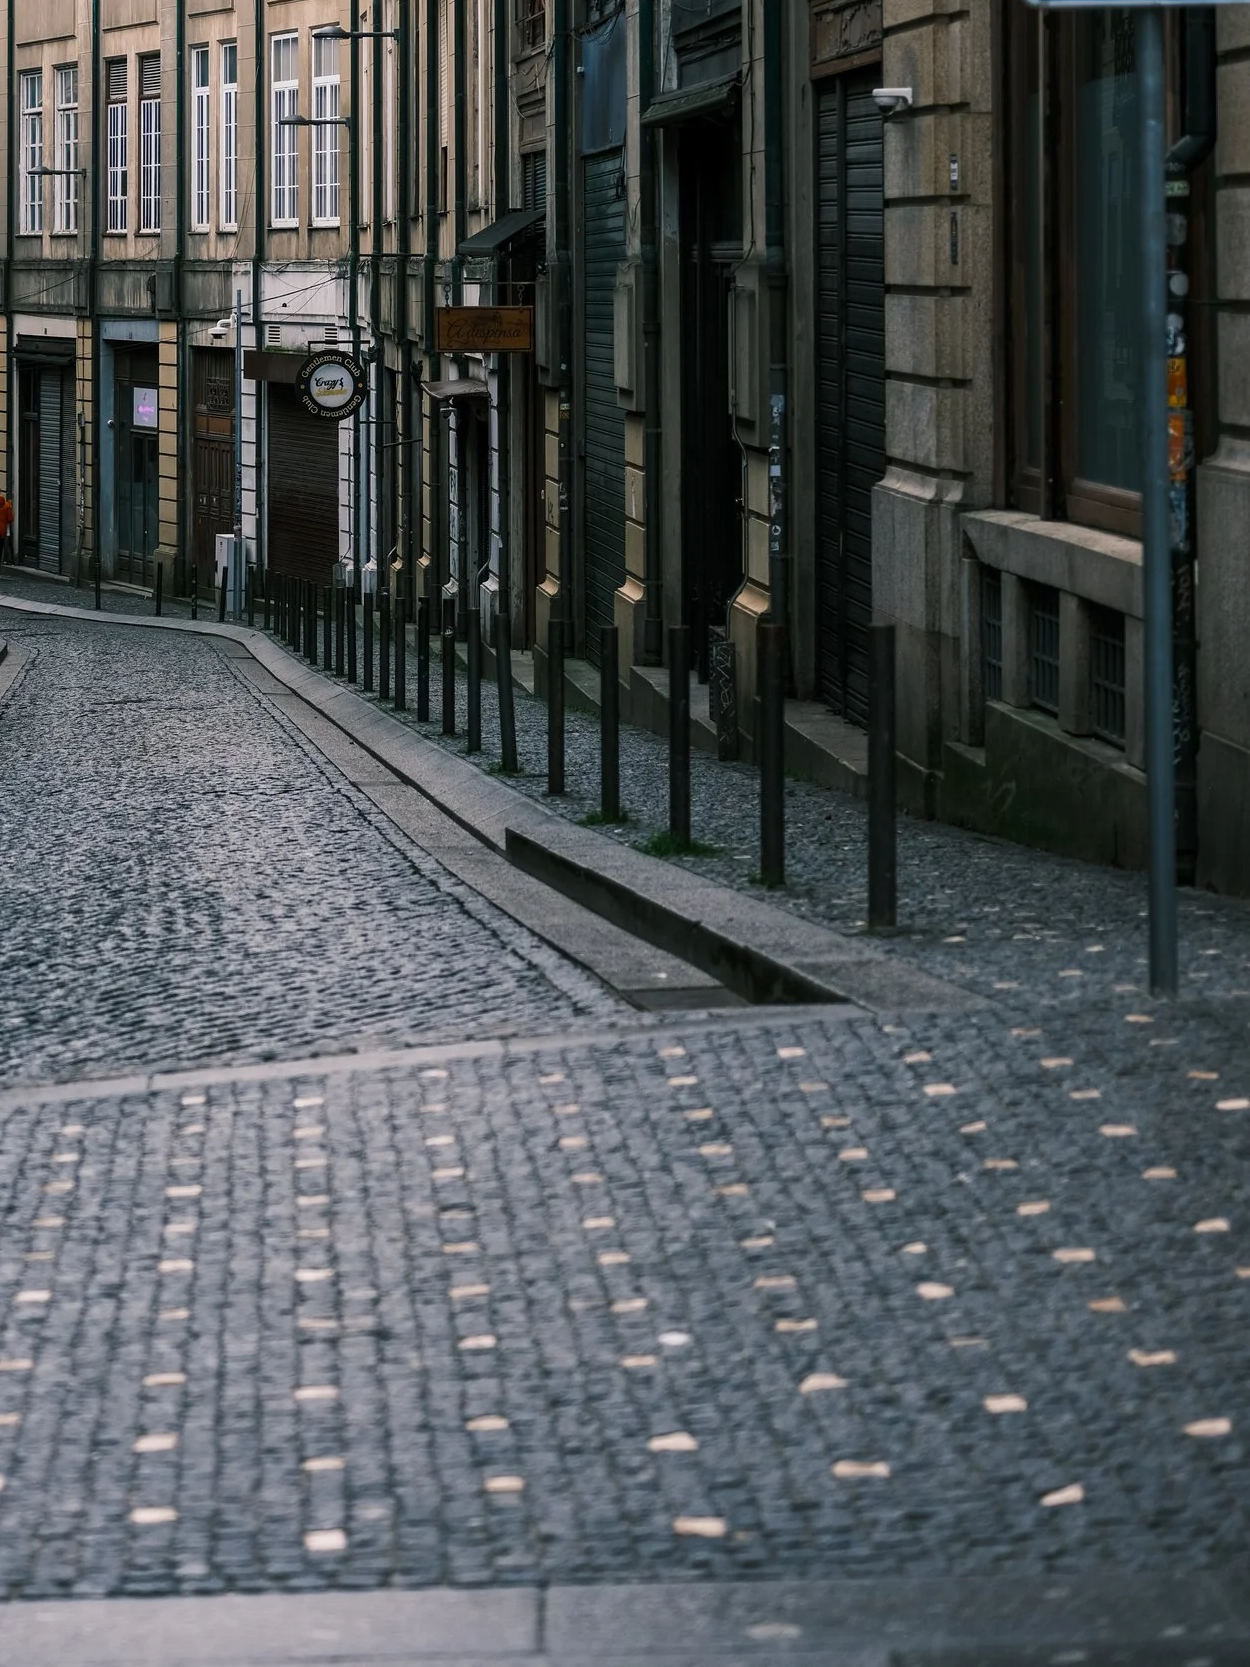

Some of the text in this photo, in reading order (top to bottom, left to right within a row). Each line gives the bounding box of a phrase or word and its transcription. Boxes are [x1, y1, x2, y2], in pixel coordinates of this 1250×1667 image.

[302, 355, 360, 378] Gentlemen Club
[303, 395, 361, 417] Gentlemen Club
